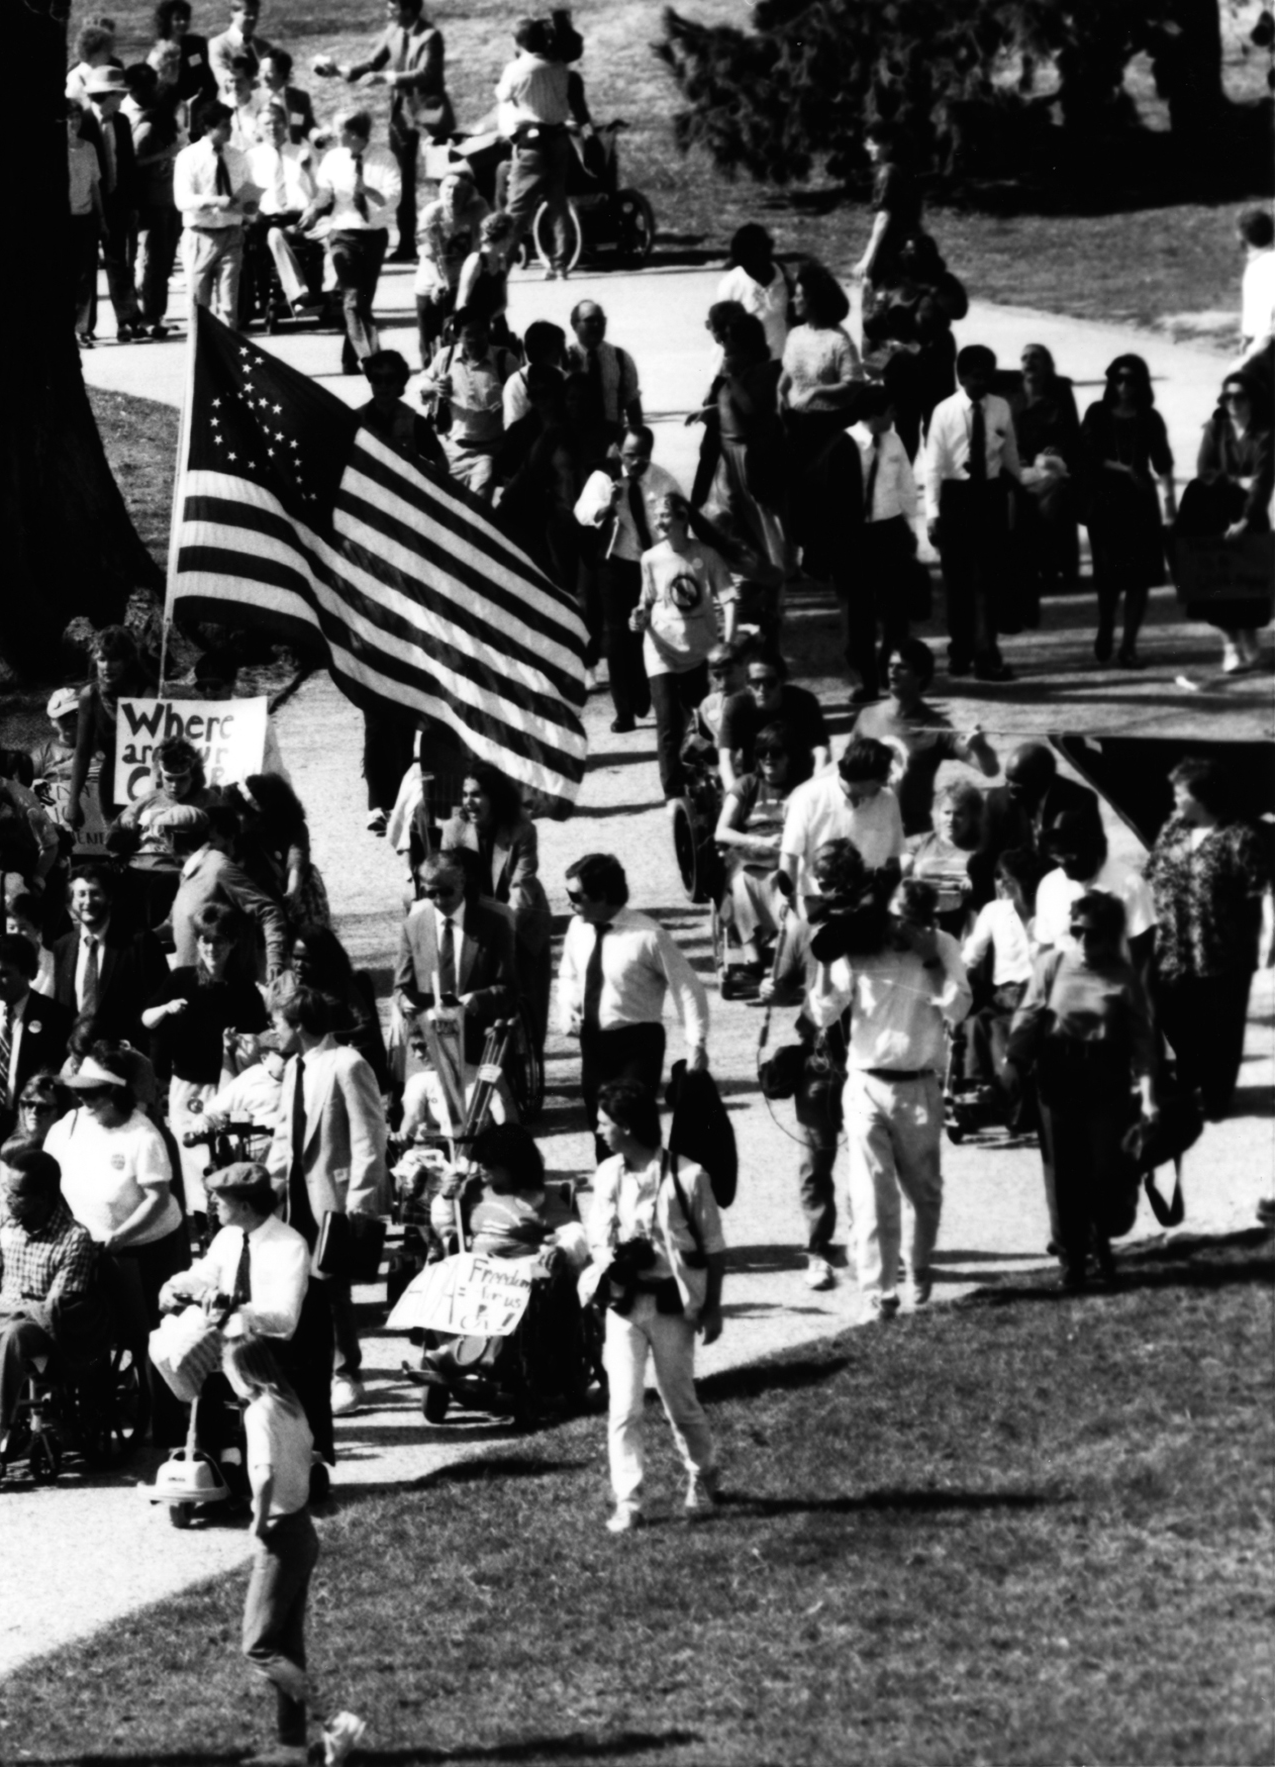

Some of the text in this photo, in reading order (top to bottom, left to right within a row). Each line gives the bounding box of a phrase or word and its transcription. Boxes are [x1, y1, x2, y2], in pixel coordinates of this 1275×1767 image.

[120, 701, 234, 742] Where
[122, 744, 157, 765] ar
[503, 1297, 521, 1309] us
